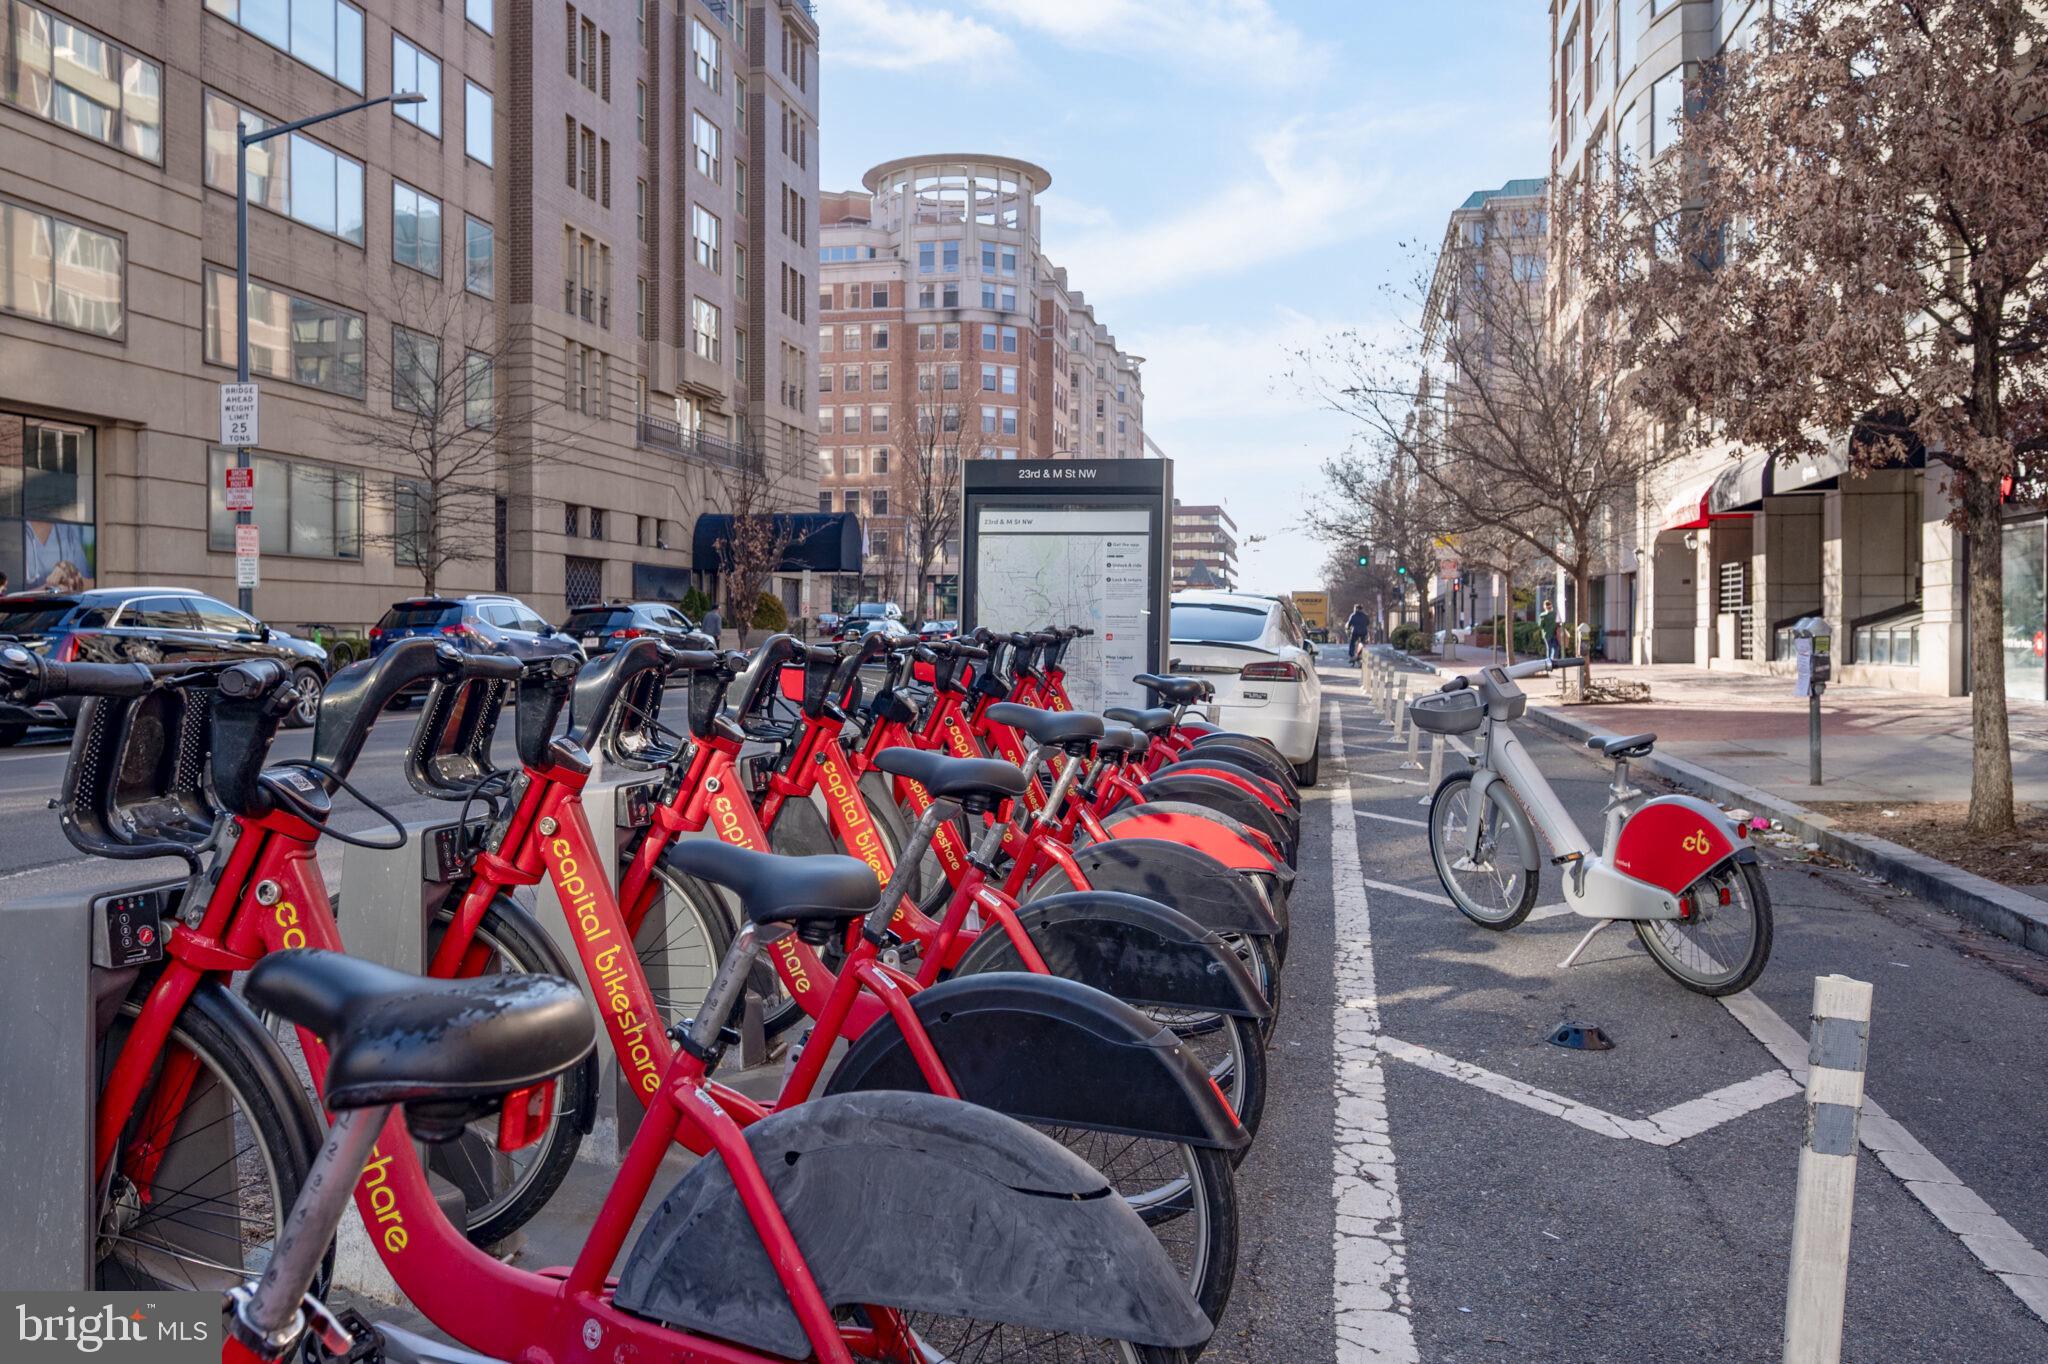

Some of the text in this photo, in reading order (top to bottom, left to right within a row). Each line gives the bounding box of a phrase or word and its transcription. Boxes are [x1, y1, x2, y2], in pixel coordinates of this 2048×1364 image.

[232, 422, 247, 433] 25
[1018, 469, 1097, 479] 23rd & M St NW
[950, 725, 973, 758] capi
[823, 760, 865, 828] capital
[716, 797, 754, 850] capi
[934, 823, 960, 871] keshare
[552, 838, 661, 1093] capital bikeshare
